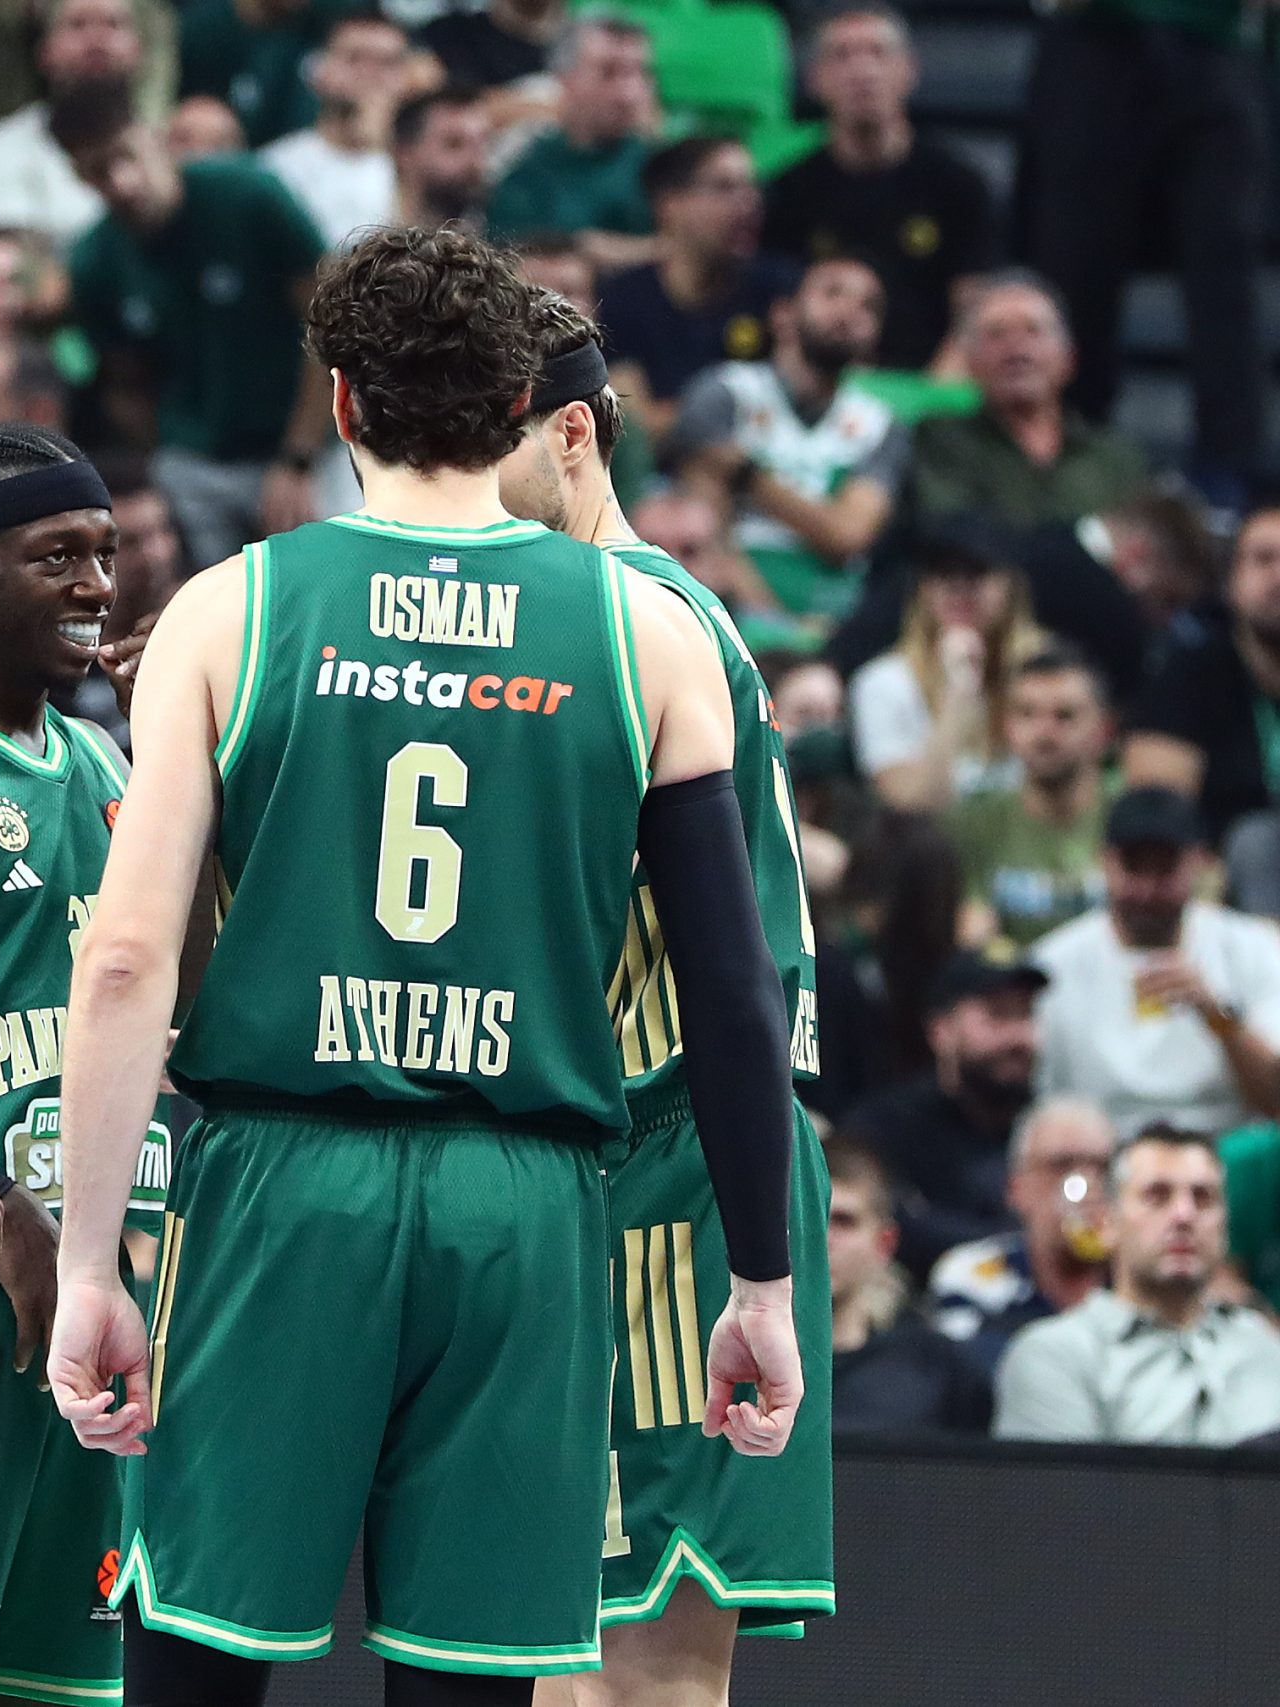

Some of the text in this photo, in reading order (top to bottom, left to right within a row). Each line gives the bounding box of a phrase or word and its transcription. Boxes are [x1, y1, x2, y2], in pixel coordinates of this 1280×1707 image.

[369, 572, 520, 648] OSMAN
[315, 645, 574, 715] instacar
[375, 741, 469, 944] 6
[314, 975, 516, 1077] ATHENS
